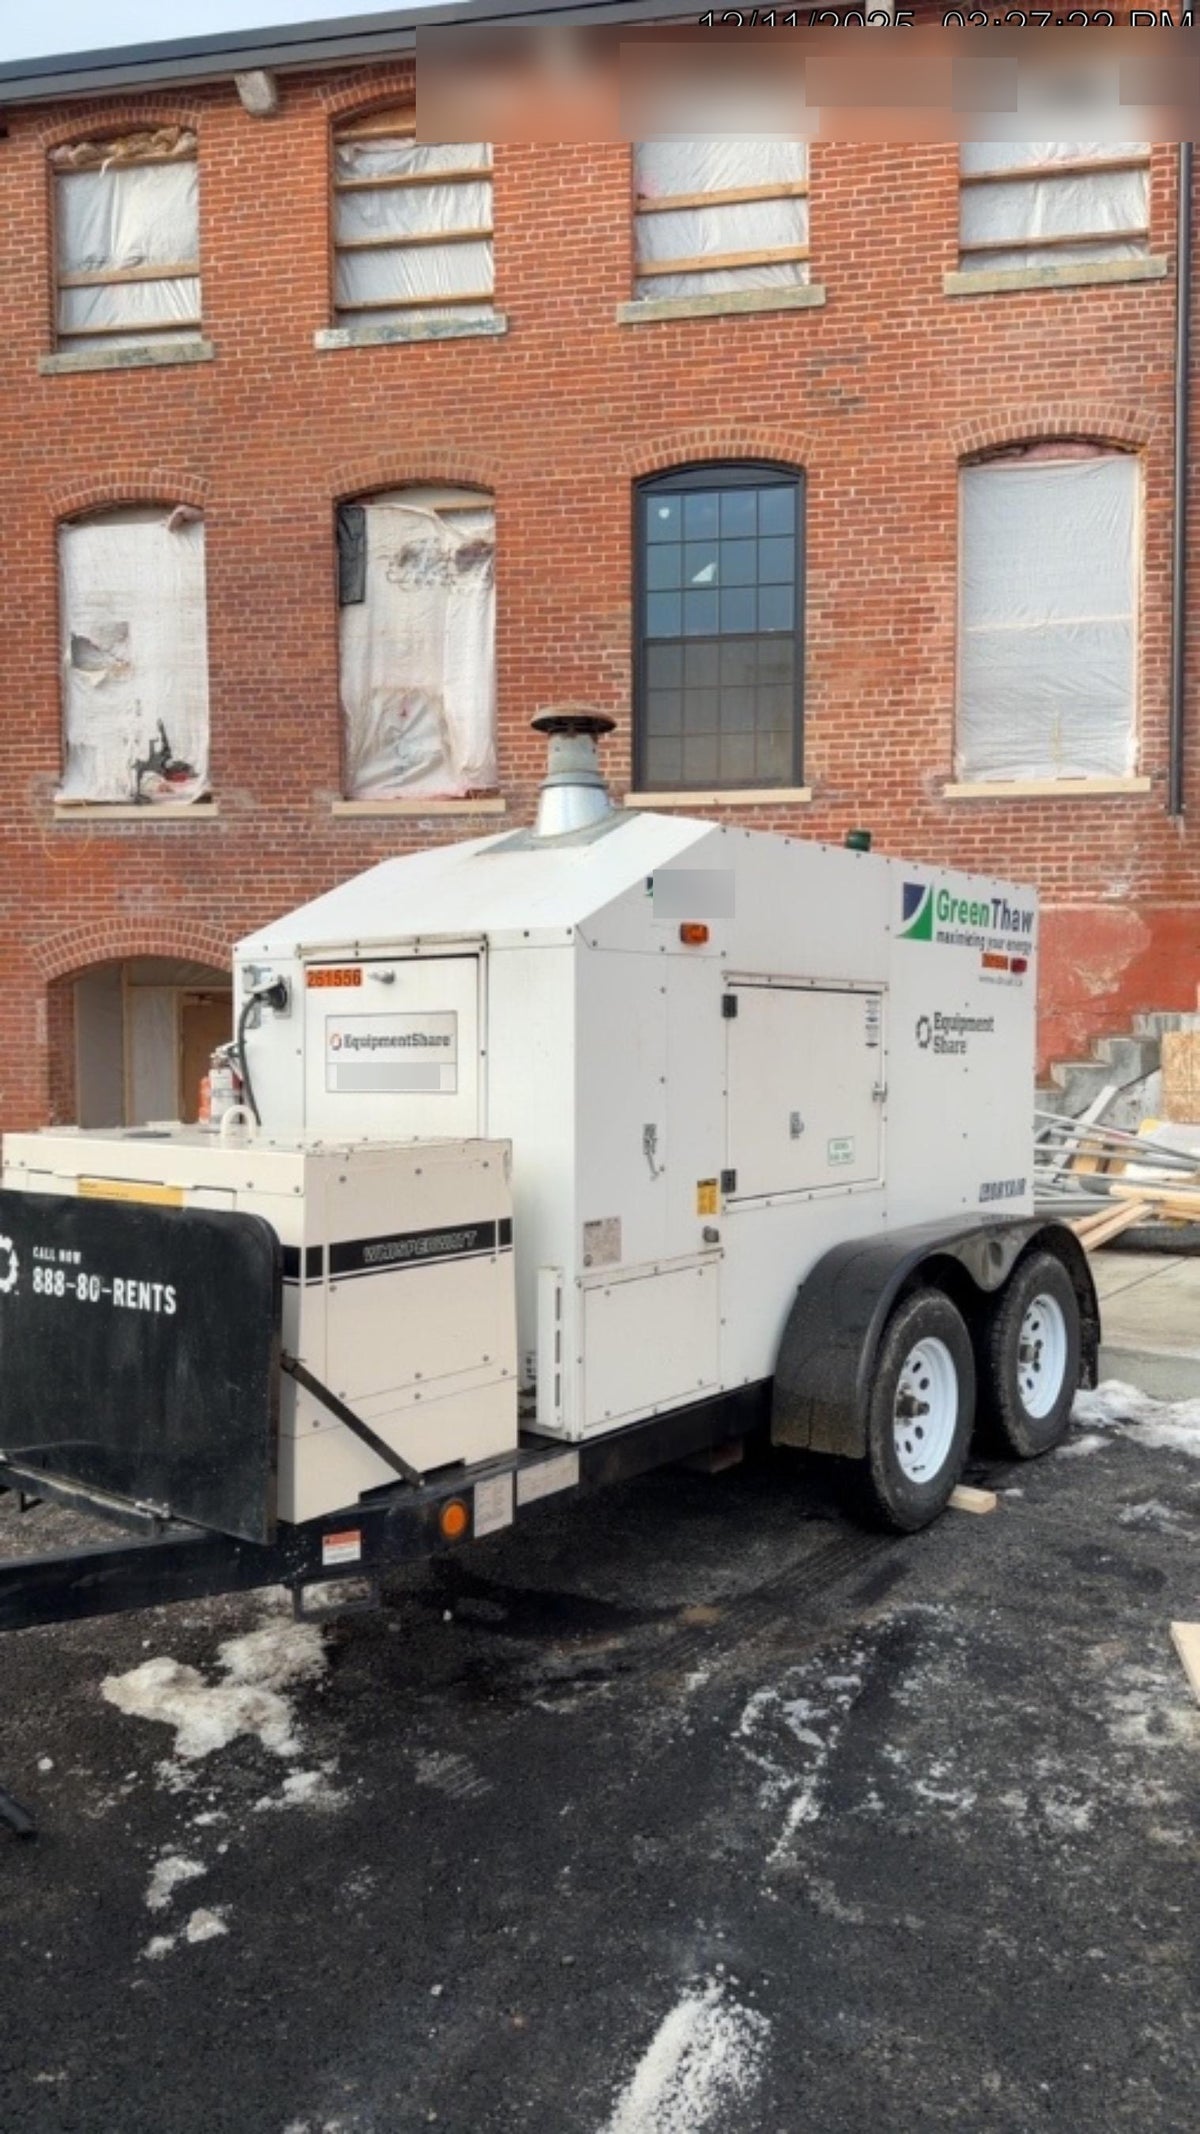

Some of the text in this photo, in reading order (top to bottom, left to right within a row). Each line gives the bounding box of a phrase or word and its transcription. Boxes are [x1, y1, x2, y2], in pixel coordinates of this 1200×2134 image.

[936, 889, 1034, 933] GreenThaw
[934, 1012, 994, 1036] Equipment
[343, 1033, 451, 1051] EquipmentShare
[934, 1035, 966, 1054] Share
[33, 1246, 82, 1265] CALL NOW
[32, 1266, 177, 1315] 888-80-RENTS
